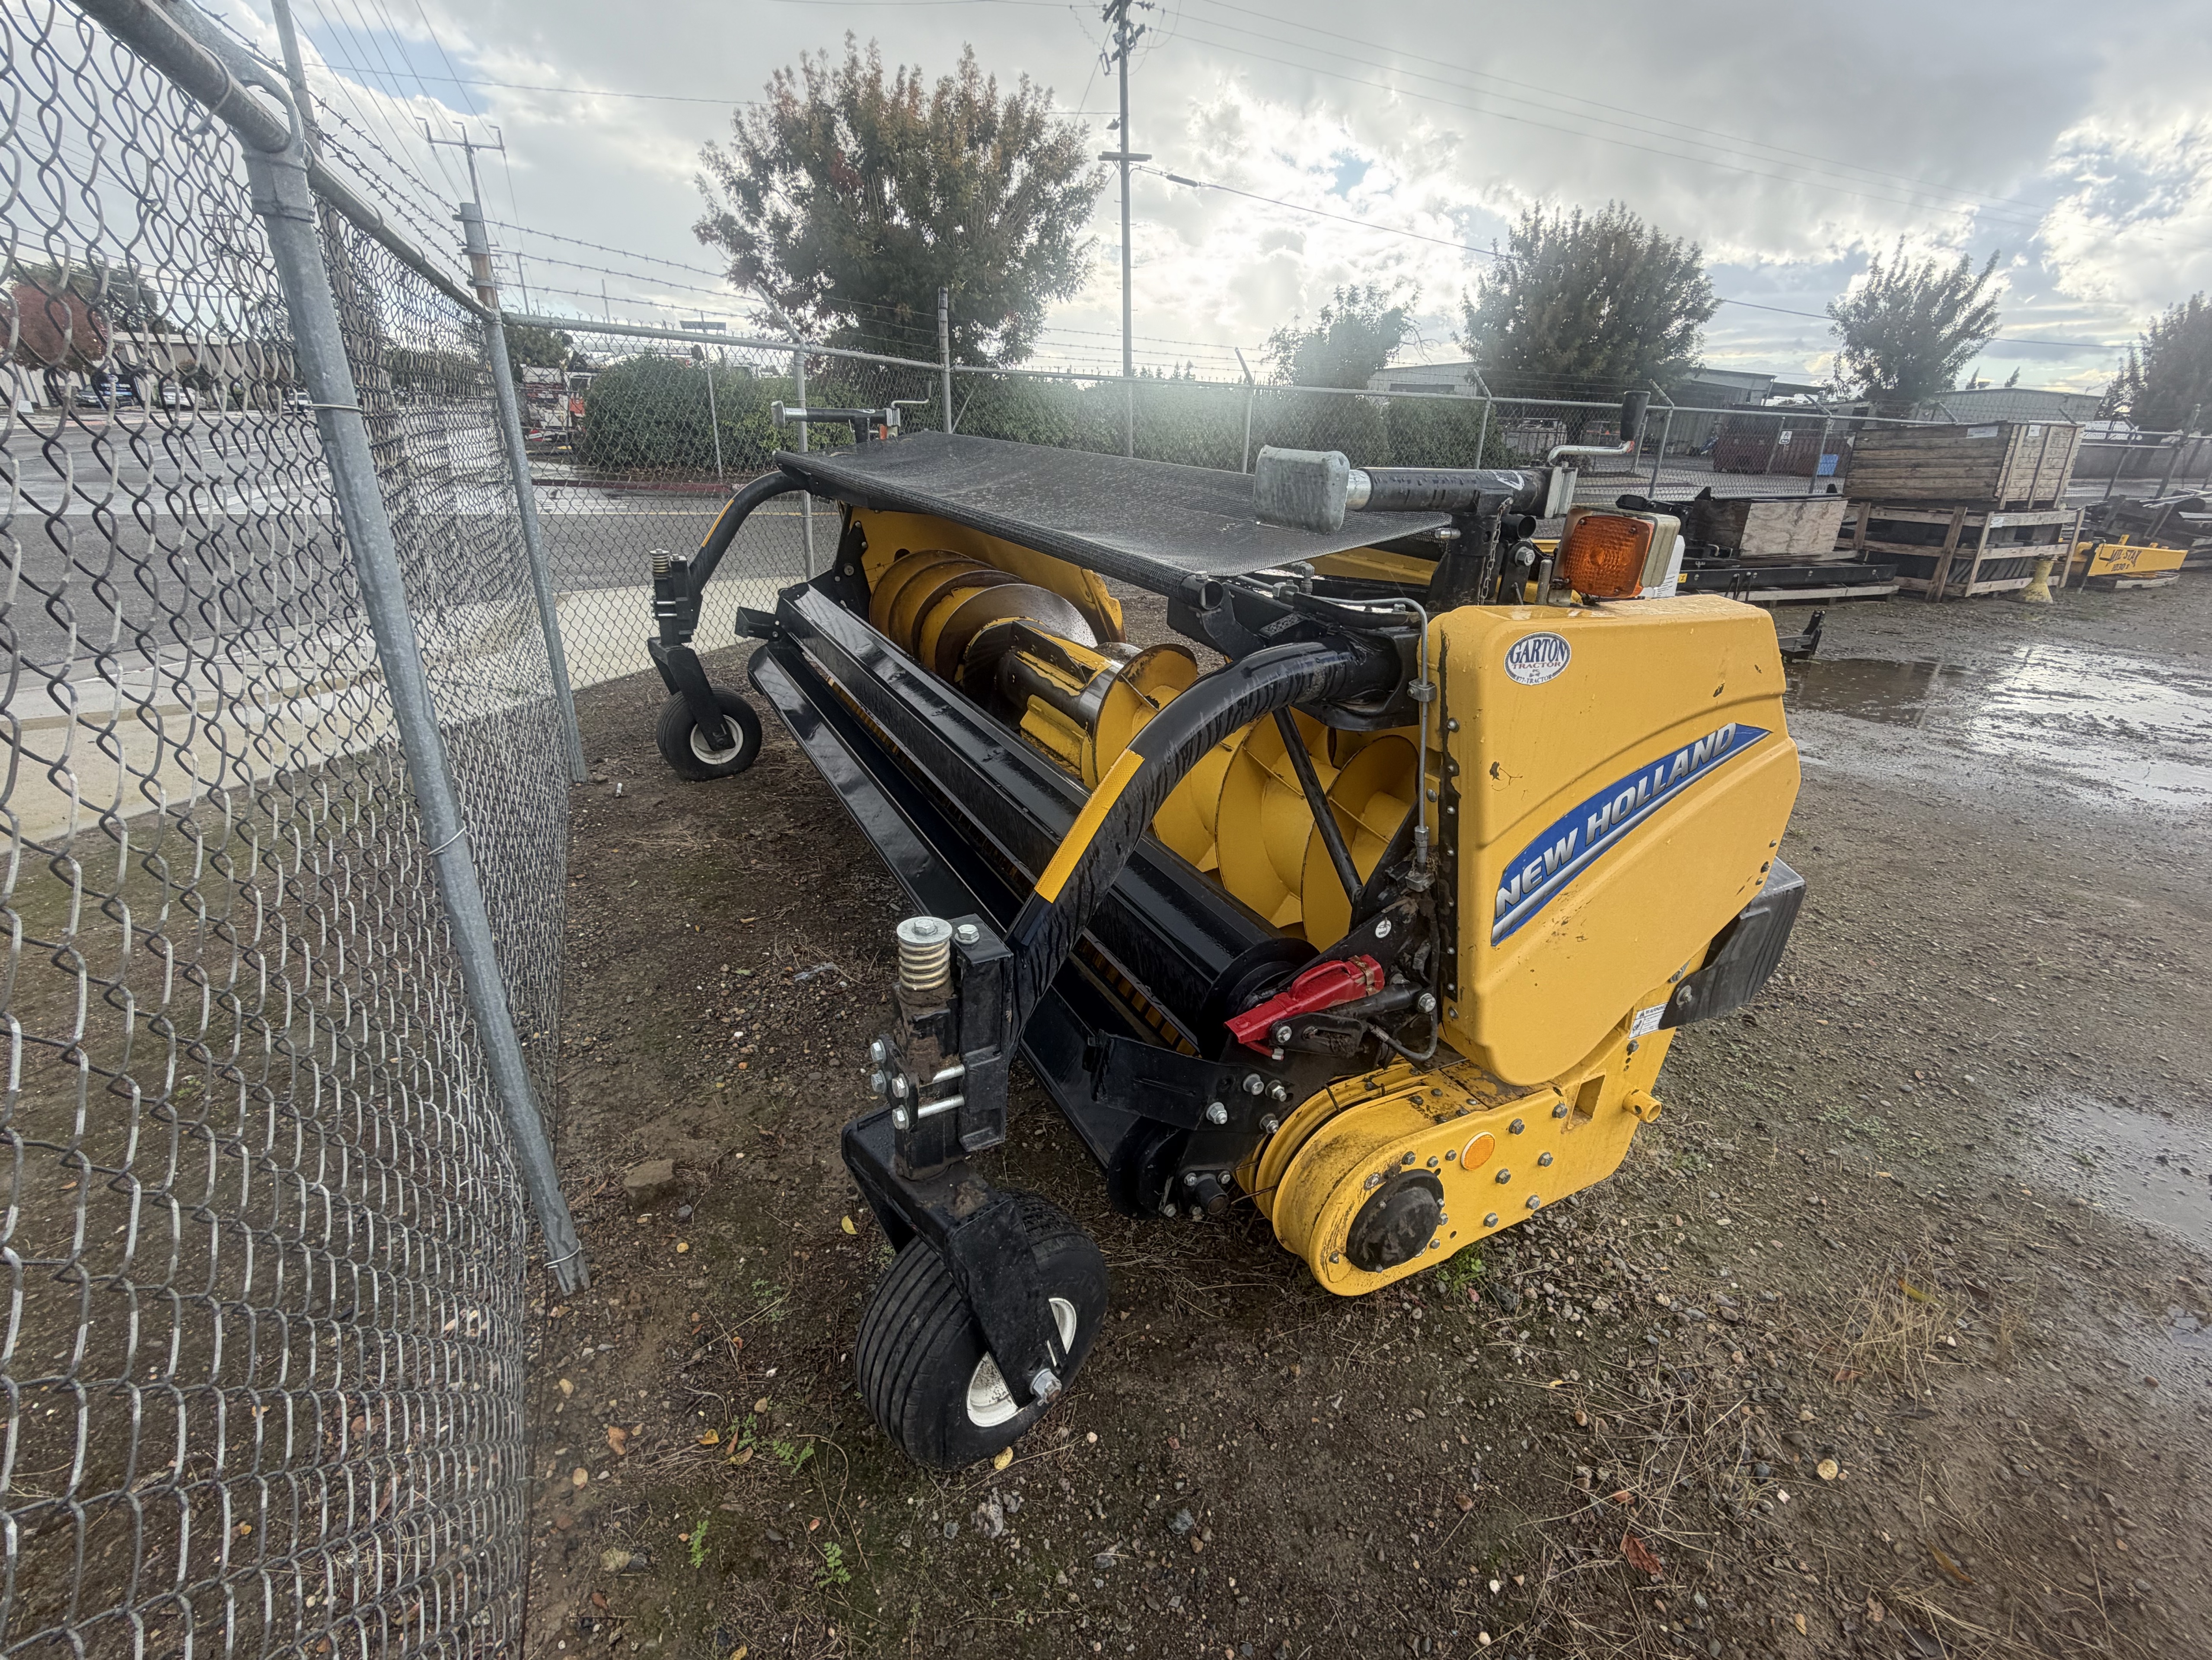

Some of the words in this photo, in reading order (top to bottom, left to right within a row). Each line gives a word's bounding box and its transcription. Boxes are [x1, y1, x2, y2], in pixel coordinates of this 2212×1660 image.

[1510, 638, 1567, 664] GARTON
[1496, 827, 1578, 918] NEW
[1585, 722, 1736, 846] HOLLAND
